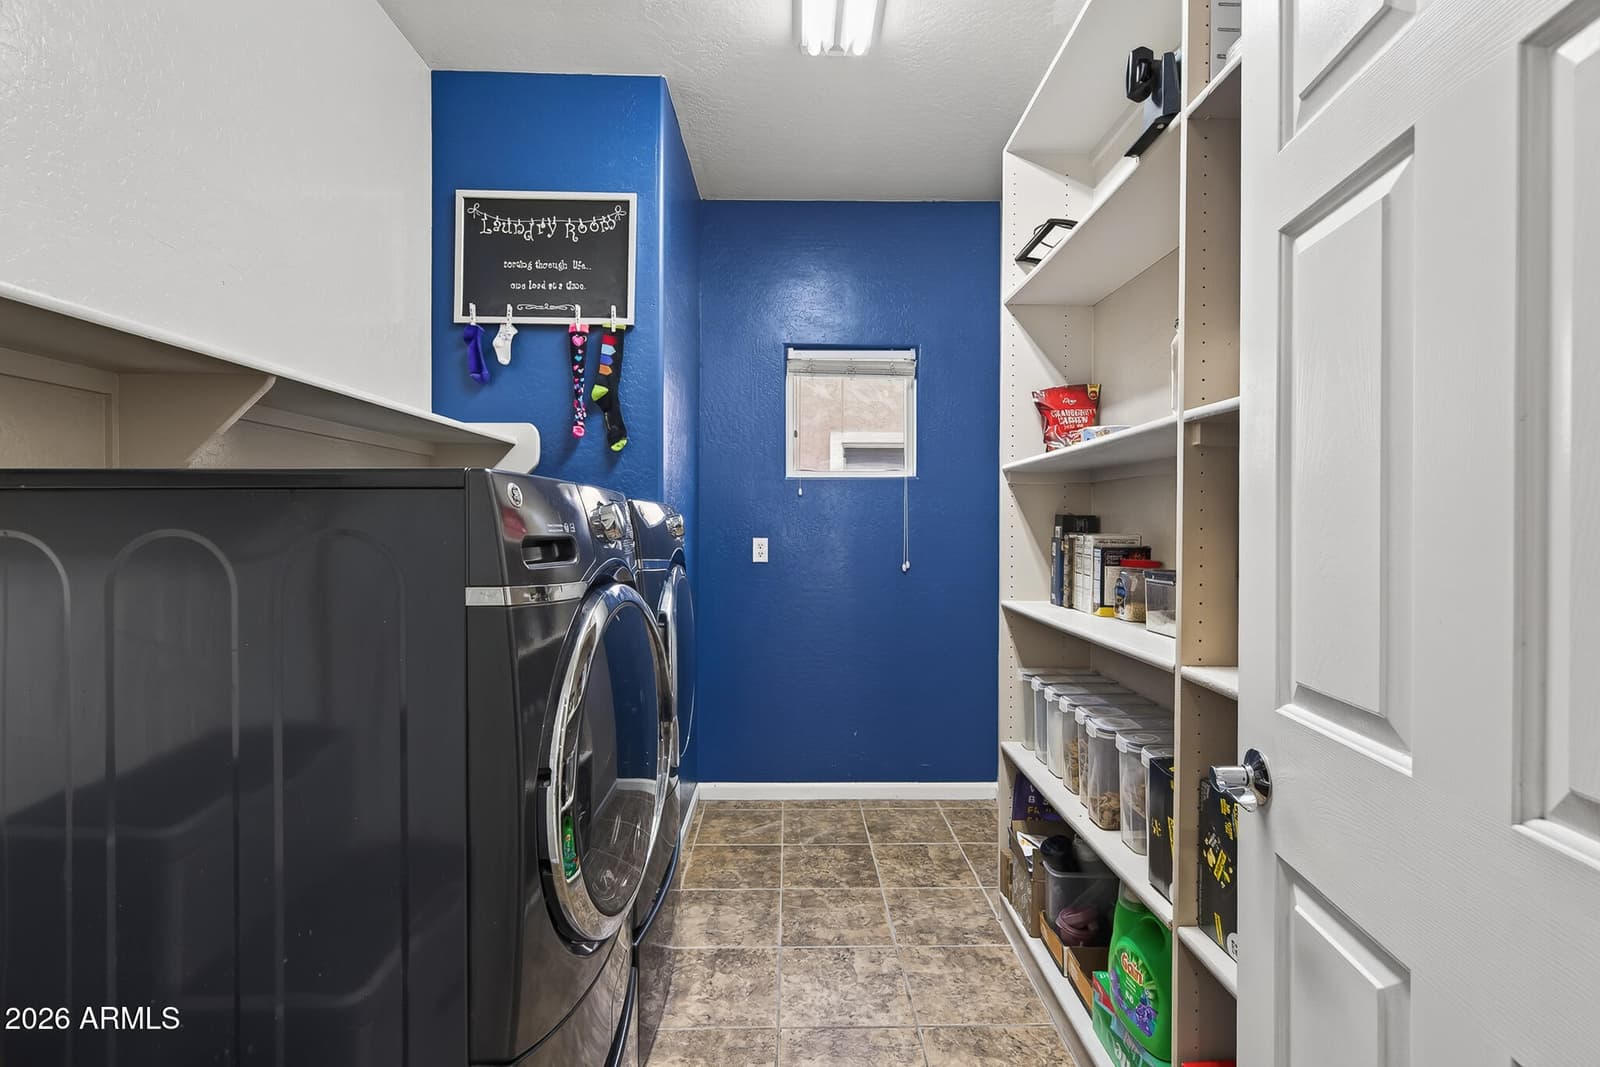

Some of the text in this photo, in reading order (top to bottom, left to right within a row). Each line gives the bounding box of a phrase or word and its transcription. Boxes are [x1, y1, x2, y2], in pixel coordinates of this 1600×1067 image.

[480, 214, 616, 242] Laundry Room
[535, 259, 568, 272] through
[510, 282, 526, 290] one
[528, 279, 546, 290] load
[1121, 952, 1144, 986] Gain
